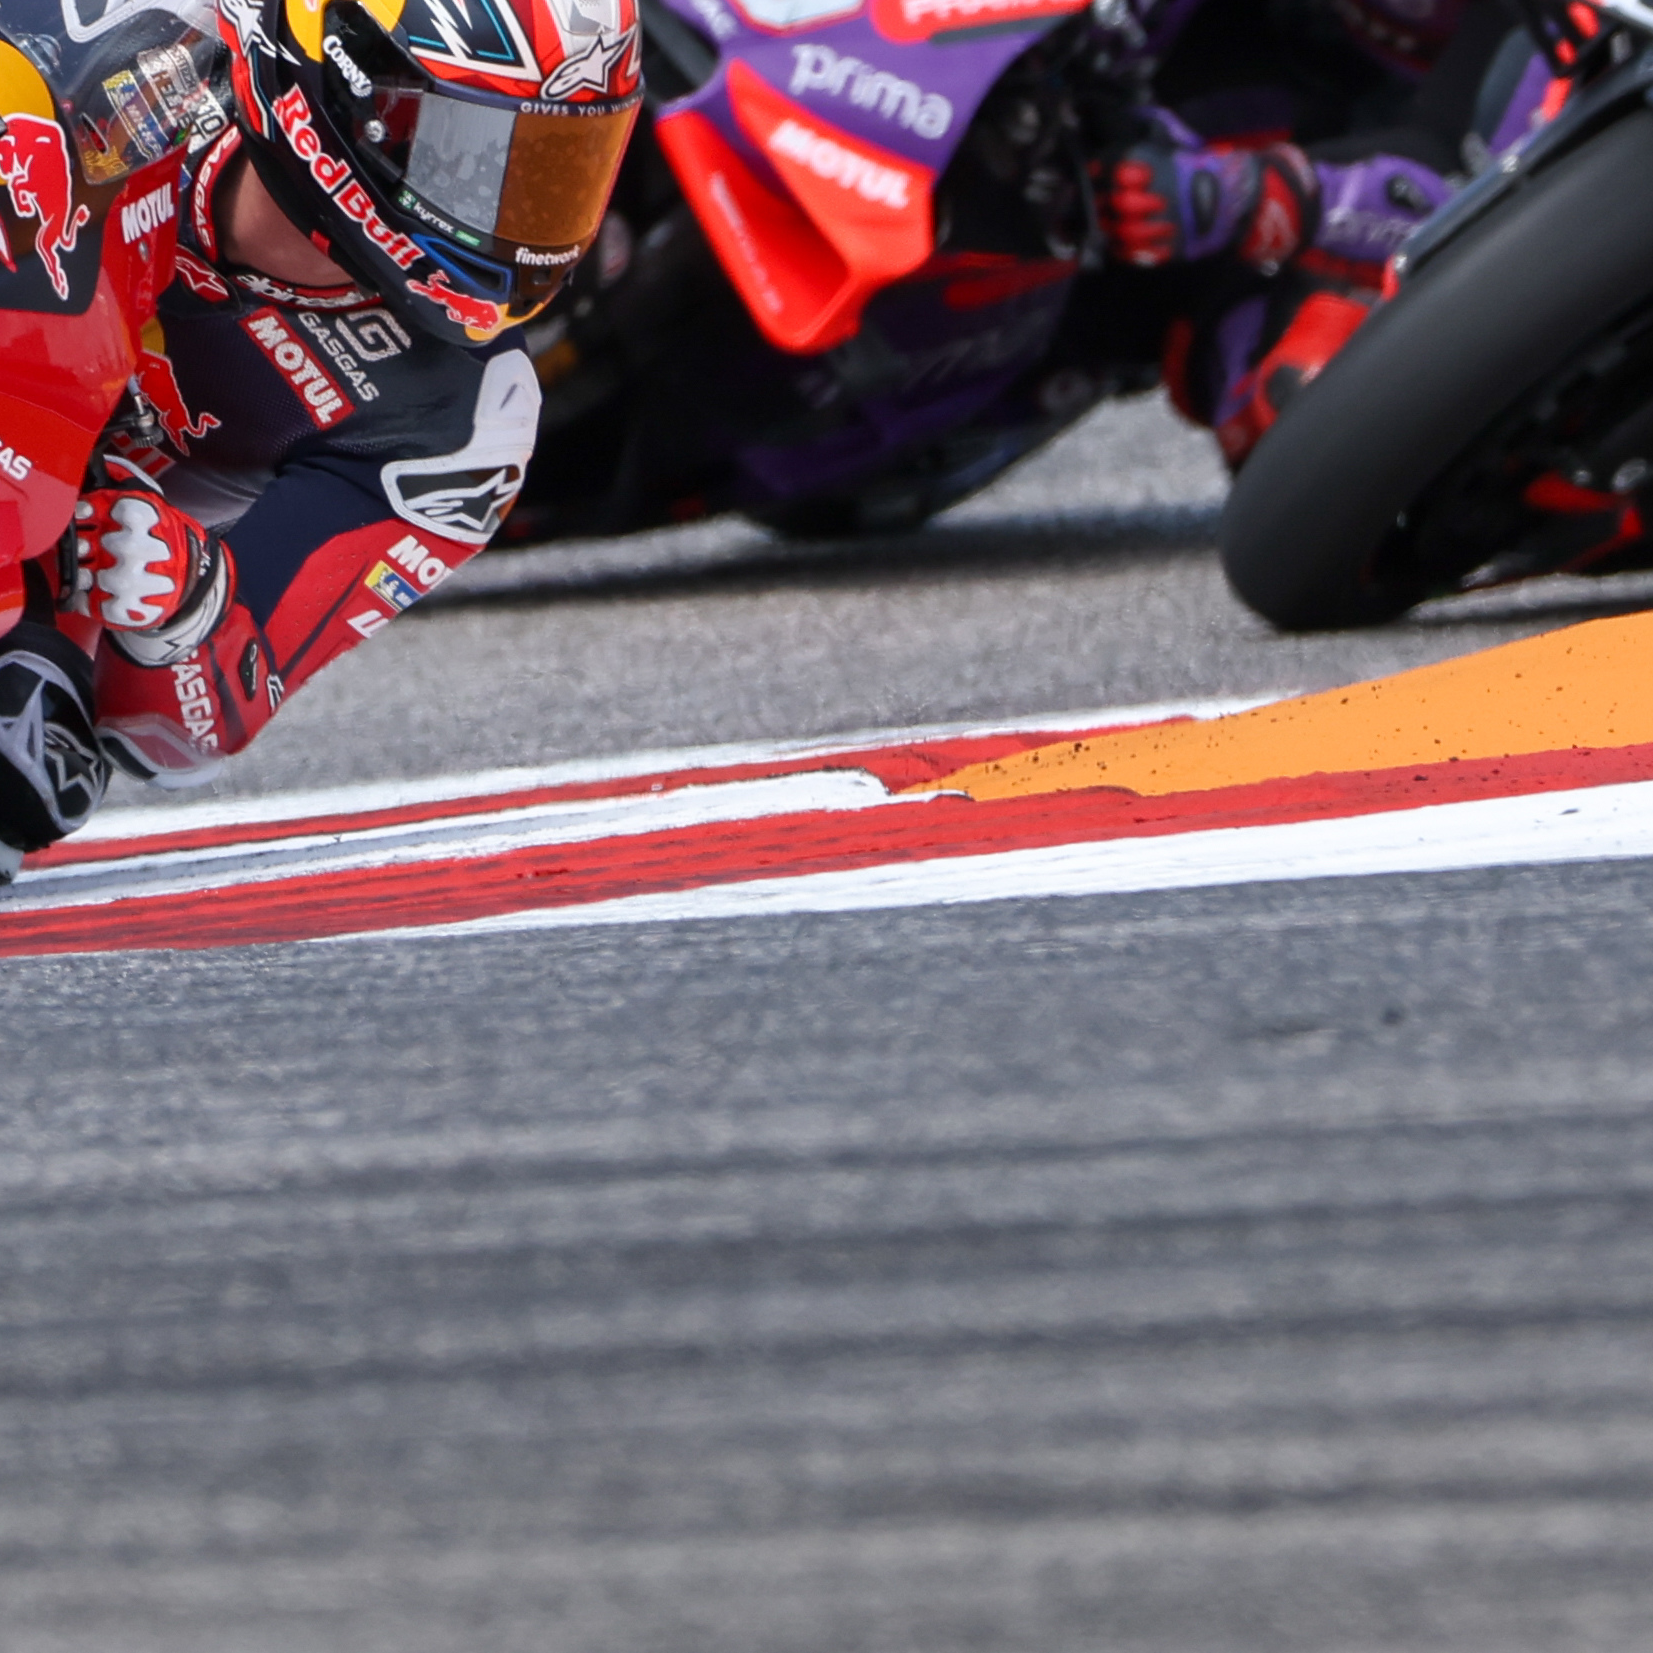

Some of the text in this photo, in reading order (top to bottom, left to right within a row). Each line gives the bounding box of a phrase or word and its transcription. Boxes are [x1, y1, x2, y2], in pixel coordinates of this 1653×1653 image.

[520, 100, 606, 117] GIVES YOU
[789, 43, 954, 140] prima
[194, 126, 240, 248] GASGAS
[274, 83, 353, 200] Red
[333, 174, 426, 270] Bull
[768, 118, 911, 211] MOTUL
[121, 181, 176, 244] MOTUL
[413, 200, 456, 234] kyrrex
[248, 314, 345, 426] MOTUL
[298, 311, 380, 403] GASGAS
